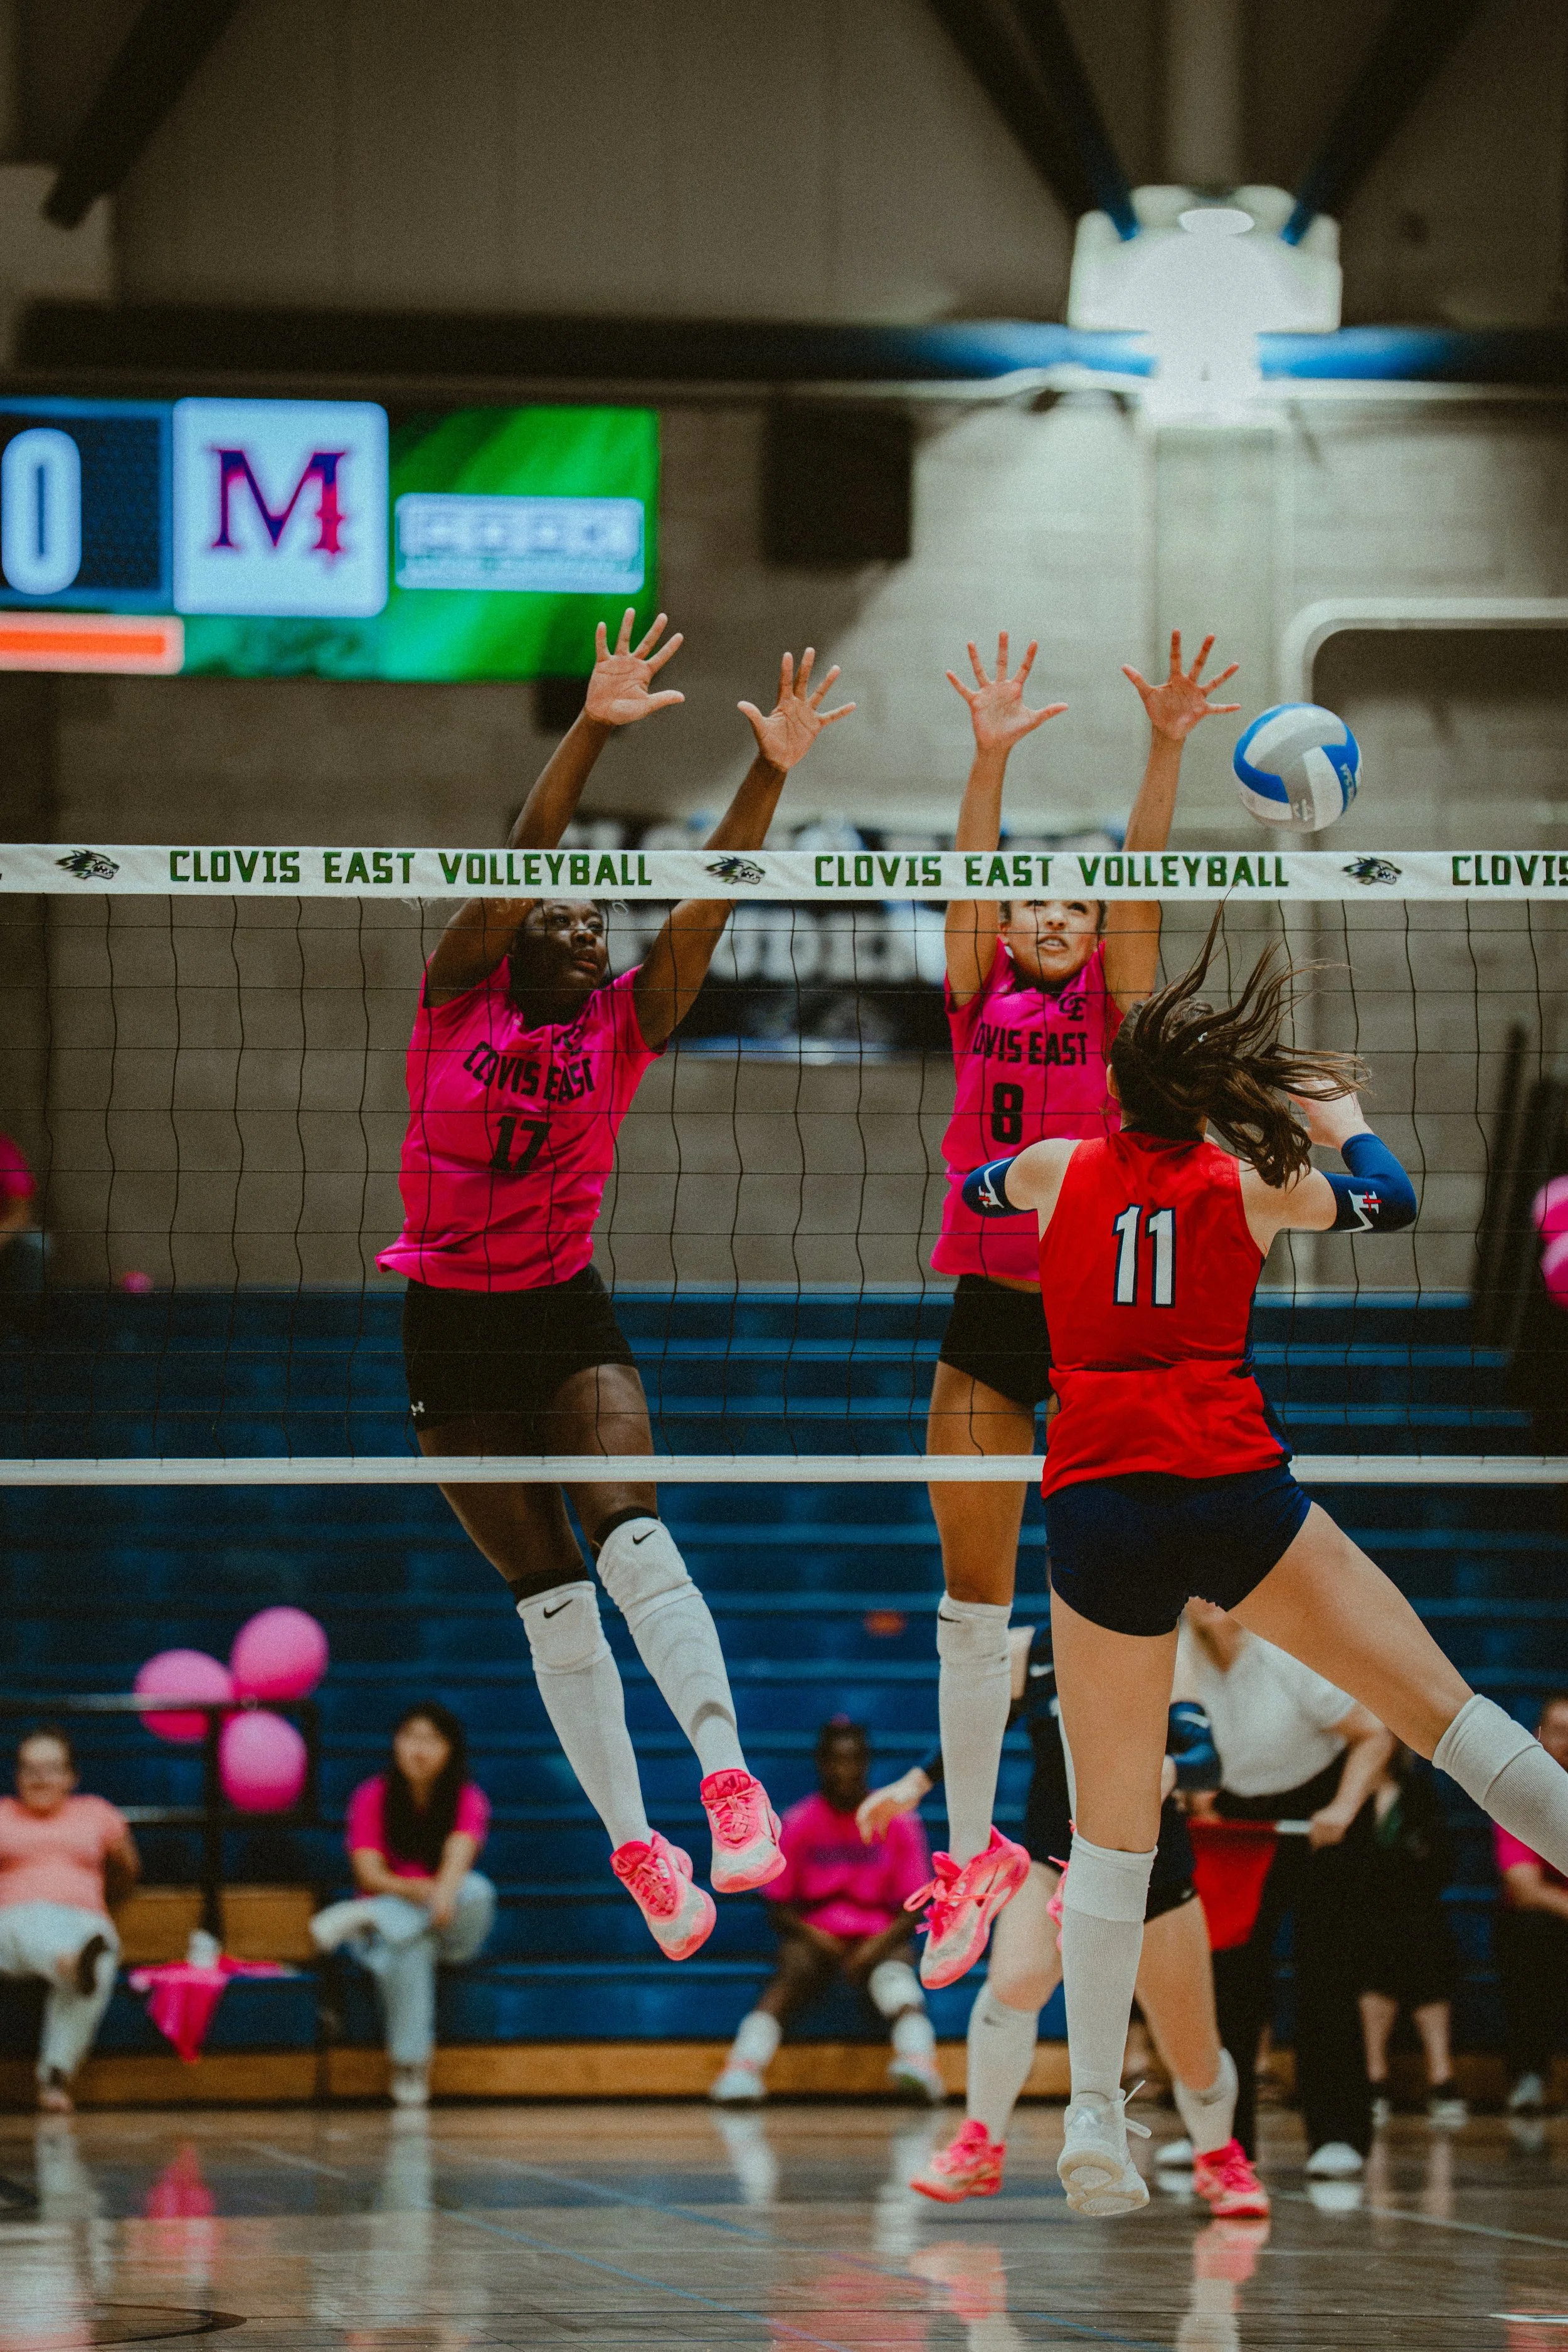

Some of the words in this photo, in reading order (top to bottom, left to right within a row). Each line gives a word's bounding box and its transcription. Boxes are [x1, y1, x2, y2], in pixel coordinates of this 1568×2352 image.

[2, 427, 82, 595] 0
[212, 448, 348, 554] M
[169, 850, 300, 883] CLOVIS
[322, 852, 415, 884] EAST
[438, 853, 652, 886] VOLLEYBALL
[815, 856, 941, 886] CLOVIS
[964, 856, 1054, 887] EAST
[1077, 856, 1290, 887] VOLLEYBALL
[1027, 1031, 1088, 1066] EAST
[543, 1057, 596, 1103] EAST
[991, 1081, 1024, 1145] 8
[489, 1115, 553, 1176] 17
[1111, 1204, 1177, 1308] 11
